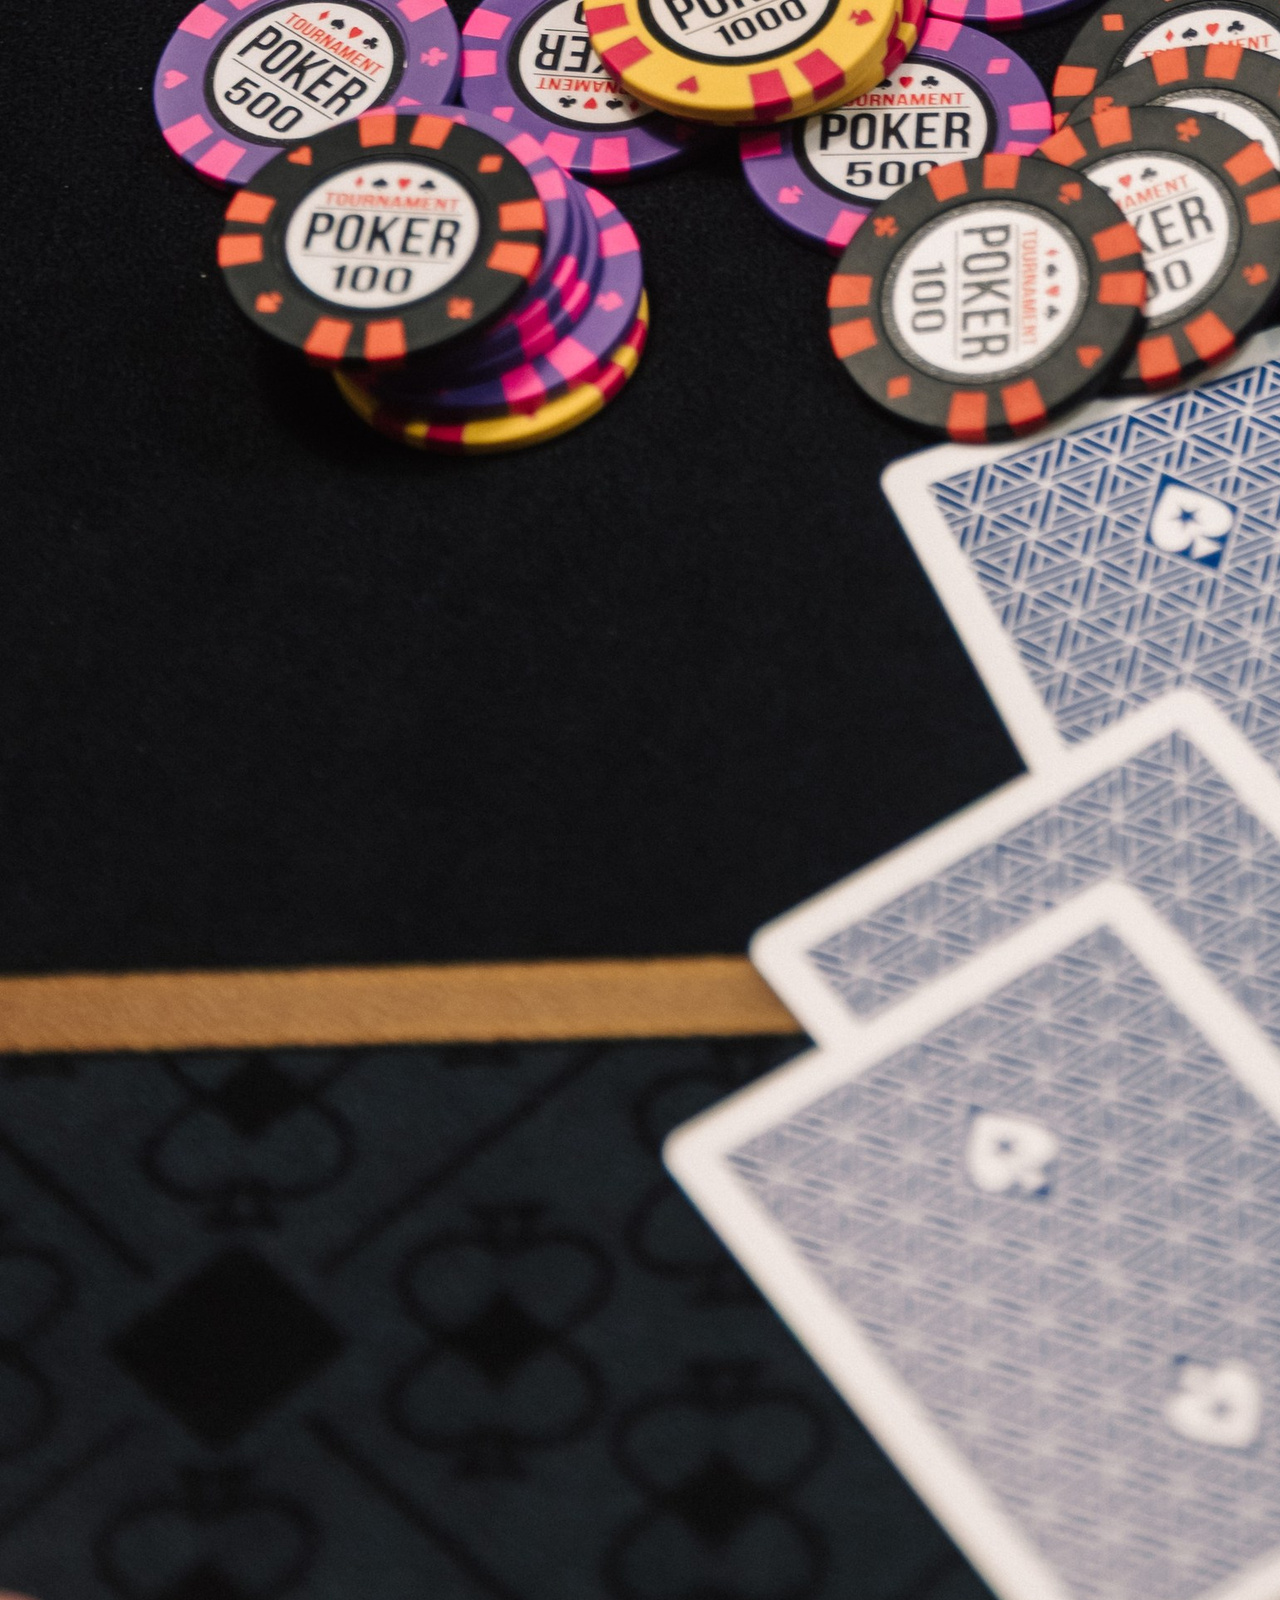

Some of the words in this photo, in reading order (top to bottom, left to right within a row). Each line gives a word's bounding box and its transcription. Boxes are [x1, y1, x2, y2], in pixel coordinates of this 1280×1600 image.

[236, 24, 368, 117] POKER
[283, 11, 385, 77] TOURNAMENT
[224, 78, 303, 135] 500
[536, 77, 627, 94] NAMENT
[820, 112, 970, 150] POKER
[324, 193, 459, 211] TOURNAMENT
[302, 212, 461, 258] POKER
[332, 265, 413, 295] 100
[911, 259, 946, 335] 100
[961, 223, 1012, 361] POKER
[1019, 229, 1040, 345] TOURNAMENT
